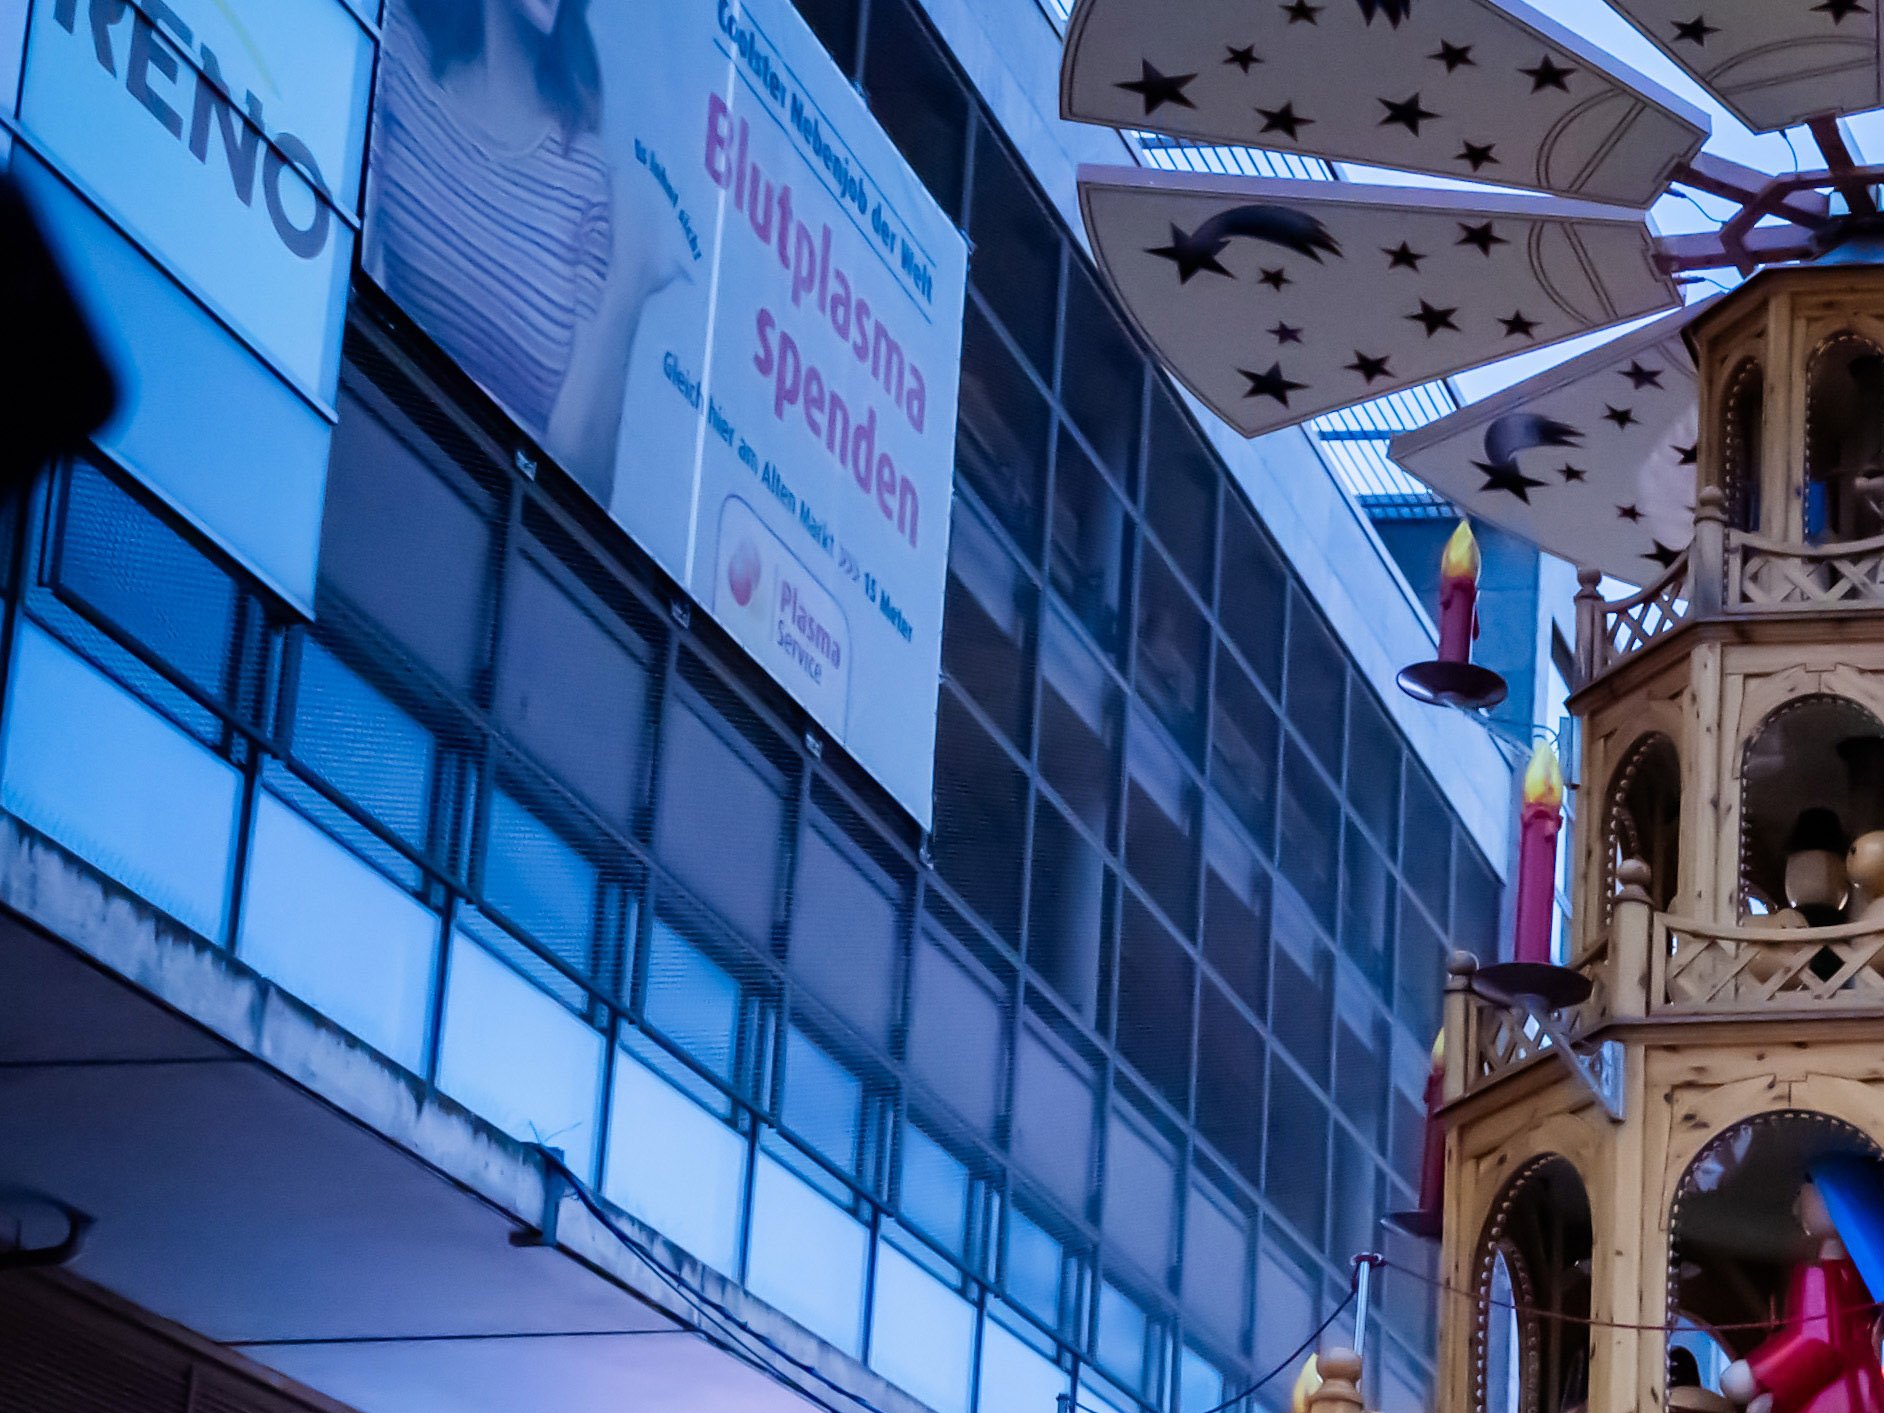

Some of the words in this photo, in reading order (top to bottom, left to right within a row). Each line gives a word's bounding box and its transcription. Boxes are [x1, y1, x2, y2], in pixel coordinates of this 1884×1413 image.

[705, 92, 927, 434] Blutplasma
[790, 92, 868, 215] Nebenjob
[871, 201, 897, 253] der
[901, 238, 934, 304] Welt
[663, 350, 704, 414] Gleich
[707, 396, 735, 447] hier
[738, 438, 759, 476] am
[761, 460, 797, 515] Alten
[799, 500, 834, 556] Markt
[880, 589, 912, 643] Meter
[753, 307, 920, 549] spenden
[776, 618, 822, 685] Service
[780, 580, 841, 670] Plasma
